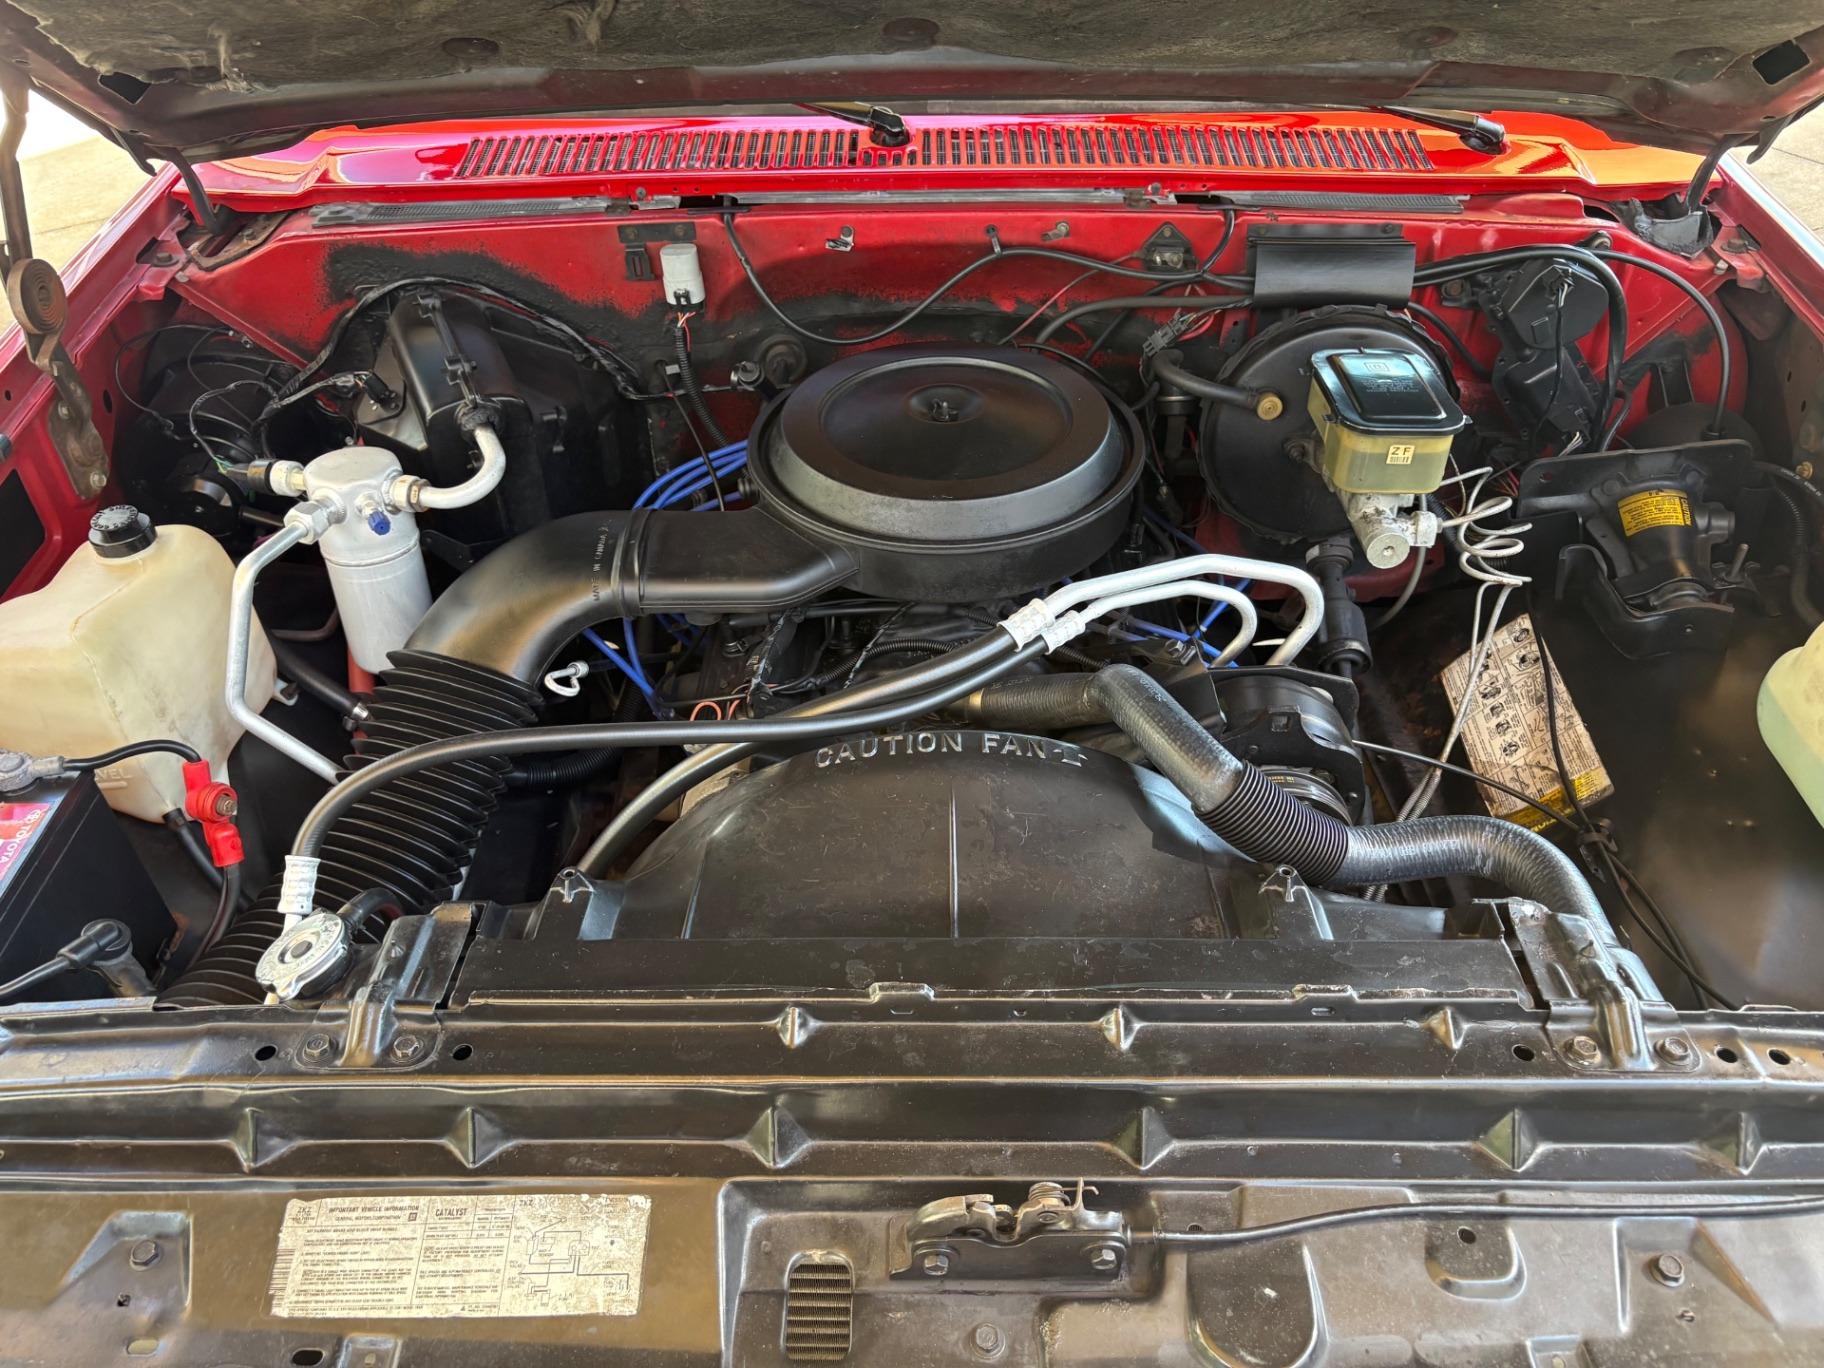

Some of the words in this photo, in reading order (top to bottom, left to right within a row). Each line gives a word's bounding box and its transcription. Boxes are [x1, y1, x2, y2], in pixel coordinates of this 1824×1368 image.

[815, 732, 963, 768] CAUTION
[982, 732, 1046, 760] FAN
[0, 822, 33, 866] TOYOTA
[435, 1207, 468, 1217] CATALYST
